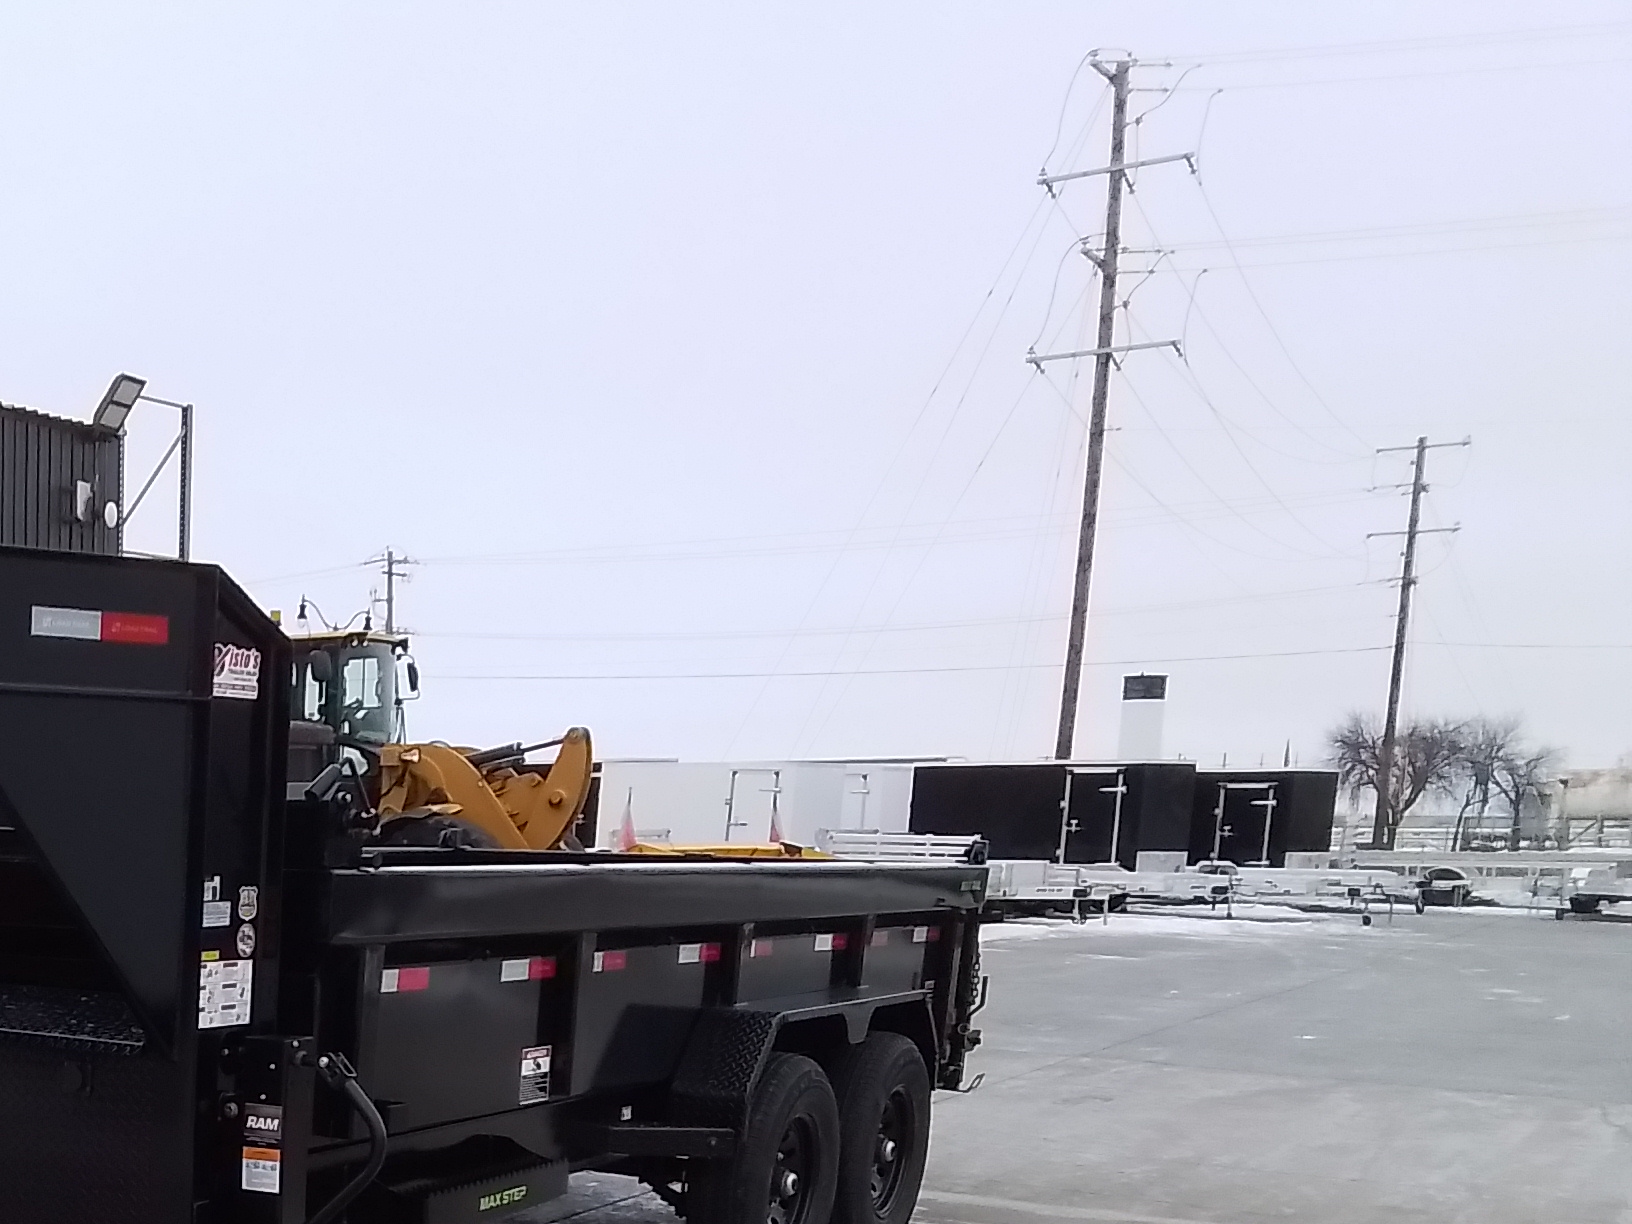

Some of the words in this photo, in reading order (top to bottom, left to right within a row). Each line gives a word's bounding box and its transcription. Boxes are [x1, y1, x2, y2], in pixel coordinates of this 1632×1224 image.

[246, 1115, 279, 1131] RAM
[479, 1193, 502, 1211] MAX
[502, 1185, 527, 1204] STEP
